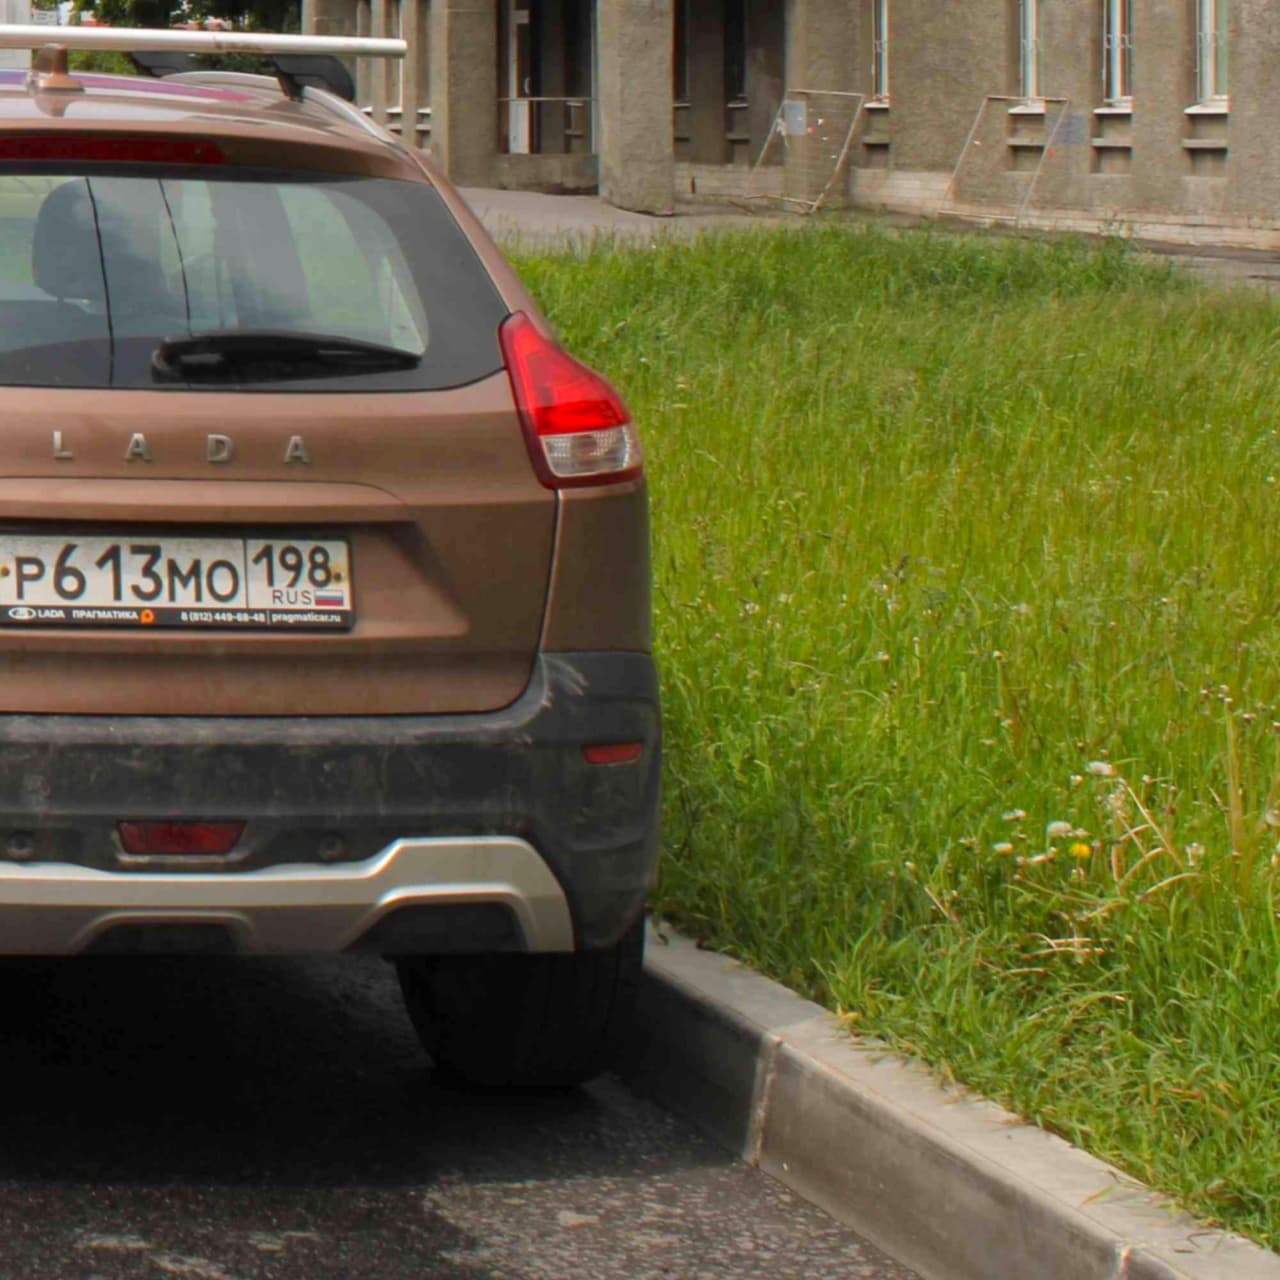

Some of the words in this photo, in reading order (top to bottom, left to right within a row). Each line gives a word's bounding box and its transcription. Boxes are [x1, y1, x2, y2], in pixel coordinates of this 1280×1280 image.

[53, 431, 310, 464] LADA
[15, 543, 239, 603] Р613МО
[252, 543, 332, 588] 198
[271, 590, 312, 605] RUS
[37, 609, 66, 619] LADA
[72, 610, 138, 620] ПРАГМАТИКА
